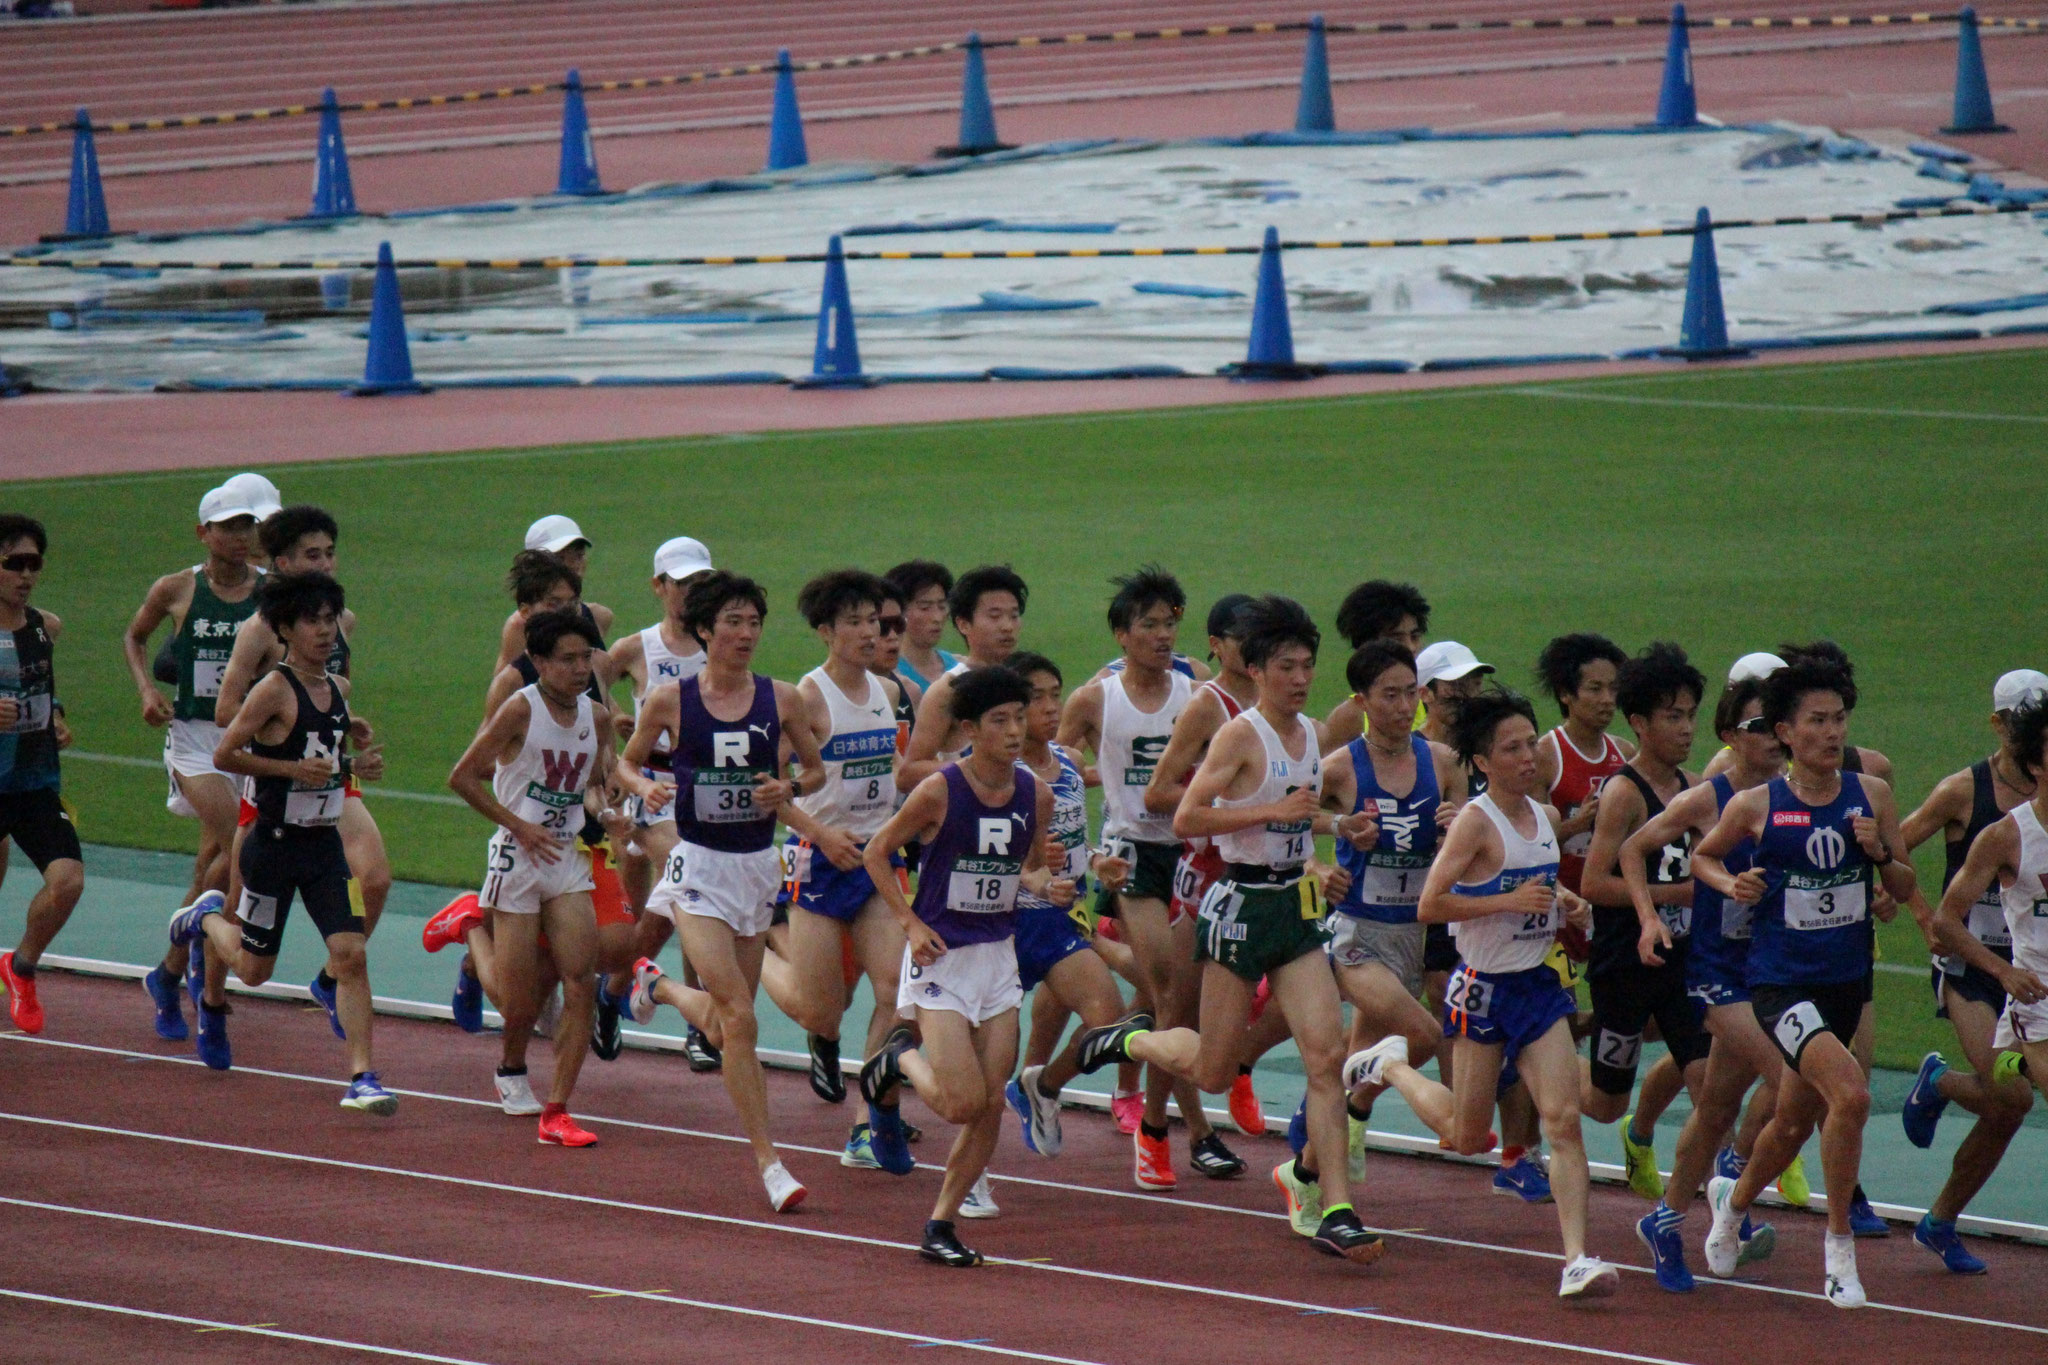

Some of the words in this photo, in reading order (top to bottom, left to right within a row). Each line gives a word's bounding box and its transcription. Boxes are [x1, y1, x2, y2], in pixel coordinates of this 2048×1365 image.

[658, 662, 680, 677] KU
[713, 731, 750, 768] R
[541, 749, 588, 792] W
[718, 789, 751, 810] 38
[867, 780, 879, 800] 8
[316, 794, 329, 816] 7
[542, 809, 568, 829] 25
[979, 818, 1012, 855] R
[1285, 836, 1304, 859] 14
[787, 849, 796, 877] 8
[955, 859, 1021, 874] 長谷工グループ
[975, 878, 1002, 900] 18
[1398, 872, 1408, 894] 1
[247, 894, 261, 921] 7
[1204, 885, 1233, 922] 14
[1309, 881, 1318, 914] 1
[1818, 892, 1836, 915] 3
[1450, 976, 1485, 1013] 28
[1783, 1013, 1803, 1042] 3
[1604, 1036, 1640, 1064] 27
